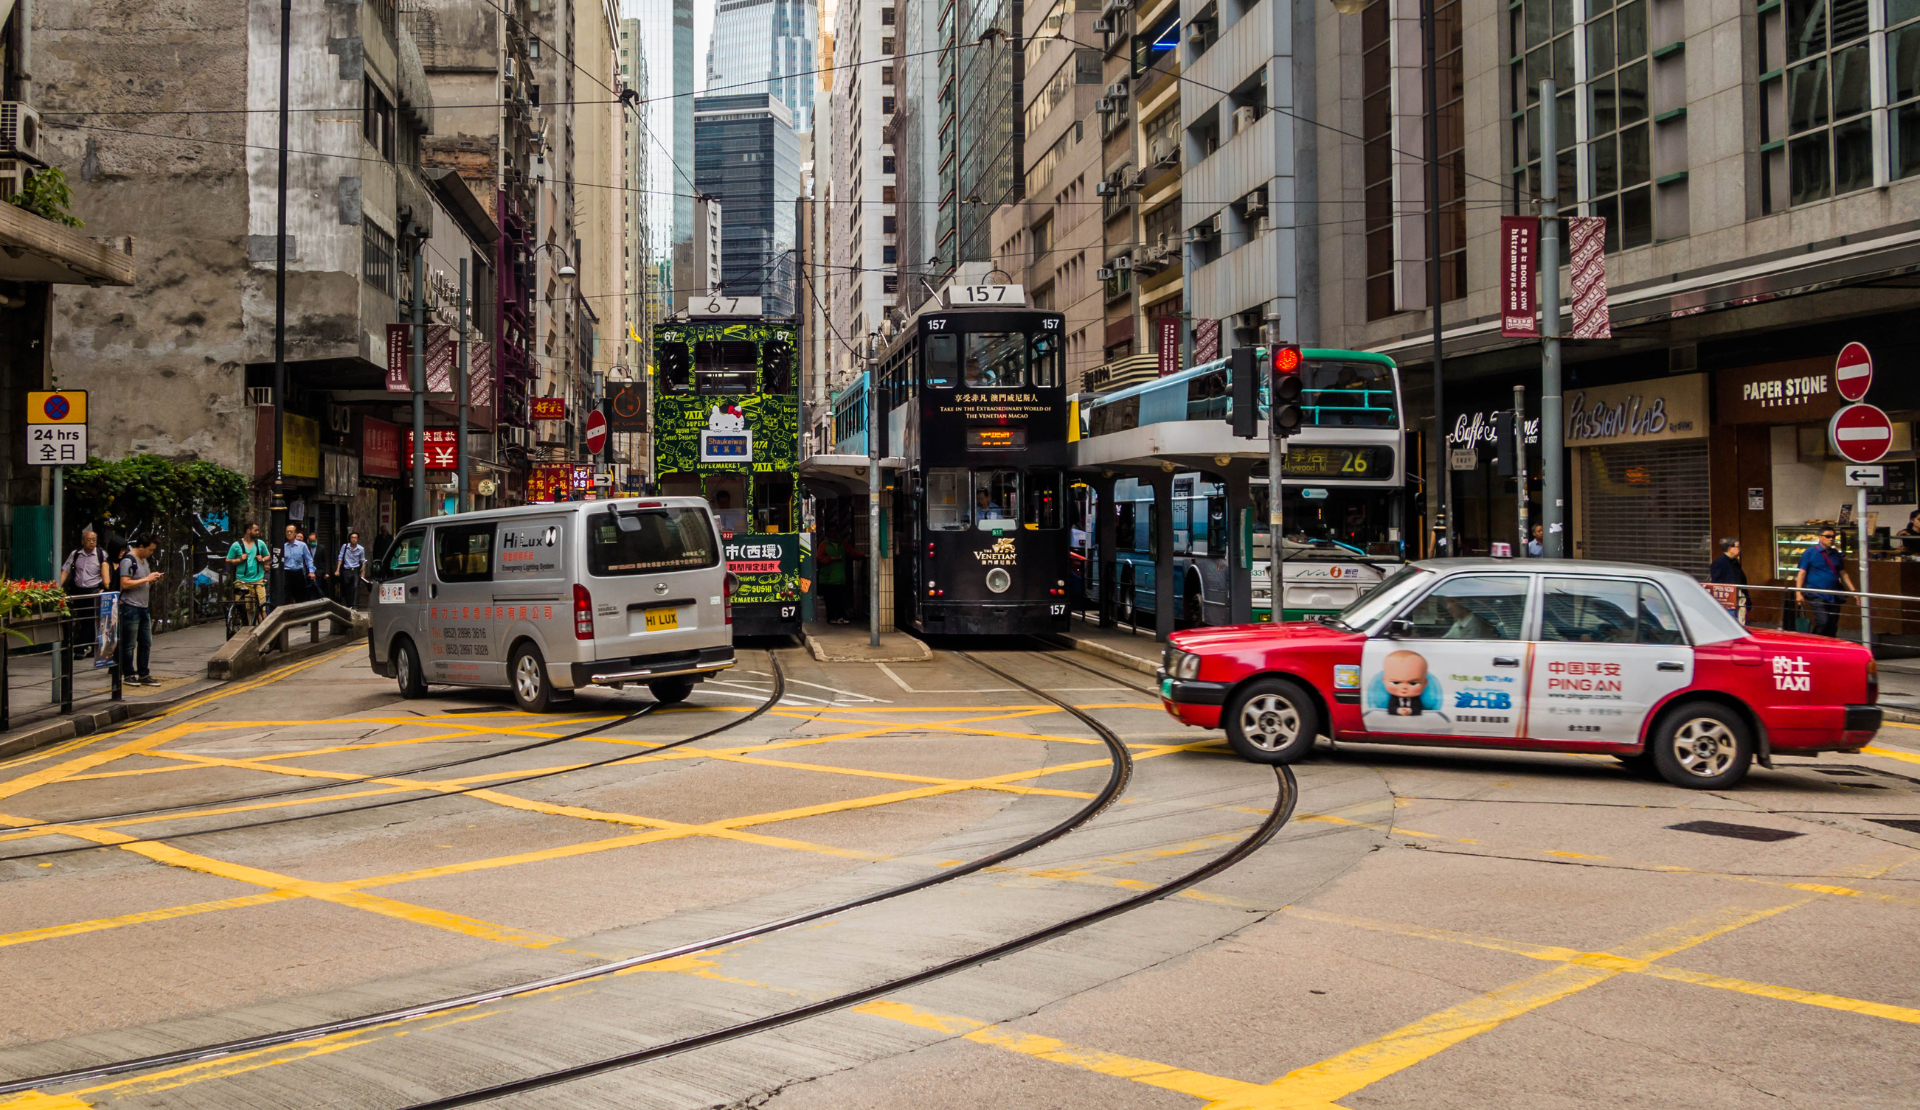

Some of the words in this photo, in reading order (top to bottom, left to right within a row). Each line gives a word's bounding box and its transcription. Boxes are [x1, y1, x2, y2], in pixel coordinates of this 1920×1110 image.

[1510, 228, 1519, 310] hktramways.com
[966, 285, 1007, 302] 157
[707, 297, 740, 313] 67
[927, 319, 947, 330] 157
[1042, 319, 1060, 329] 157
[664, 331, 678, 341] 67
[776, 331, 789, 341] 67
[1743, 380, 1784, 400] PAPER
[1785, 375, 1828, 396] STONE
[954, 394, 988, 403] 享受非凡
[990, 394, 1038, 403] 澳門威尼斯人
[1761, 396, 1809, 408] BAKERY
[684, 410, 705, 420] YATA
[1567, 391, 1634, 439] PASSION
[1630, 395, 1668, 435] LAB
[34, 429, 53, 440] 24
[57, 429, 79, 440] hrs
[40, 444, 75, 460] 全日
[752, 462, 774, 473] YATA
[1282, 463, 1316, 472] ollywood
[1341, 450, 1367, 472] 26
[504, 532, 518, 548] Hi
[520, 532, 543, 547] Lux
[722, 543, 783, 560] 市(西環)
[973, 551, 1016, 560] VENETIAN
[752, 585, 772, 593] SUSHI
[781, 606, 796, 618] 67
[1050, 604, 1066, 615] 157
[645, 615, 656, 626] HI
[659, 613, 677, 625] LUX
[443, 627, 456, 641] (852)
[472, 627, 487, 639] 3616
[446, 644, 459, 657] (852)
[1548, 661, 1622, 676] 中国平安
[1772, 655, 1811, 675] 的士
[1772, 675, 1811, 692] TAXI
